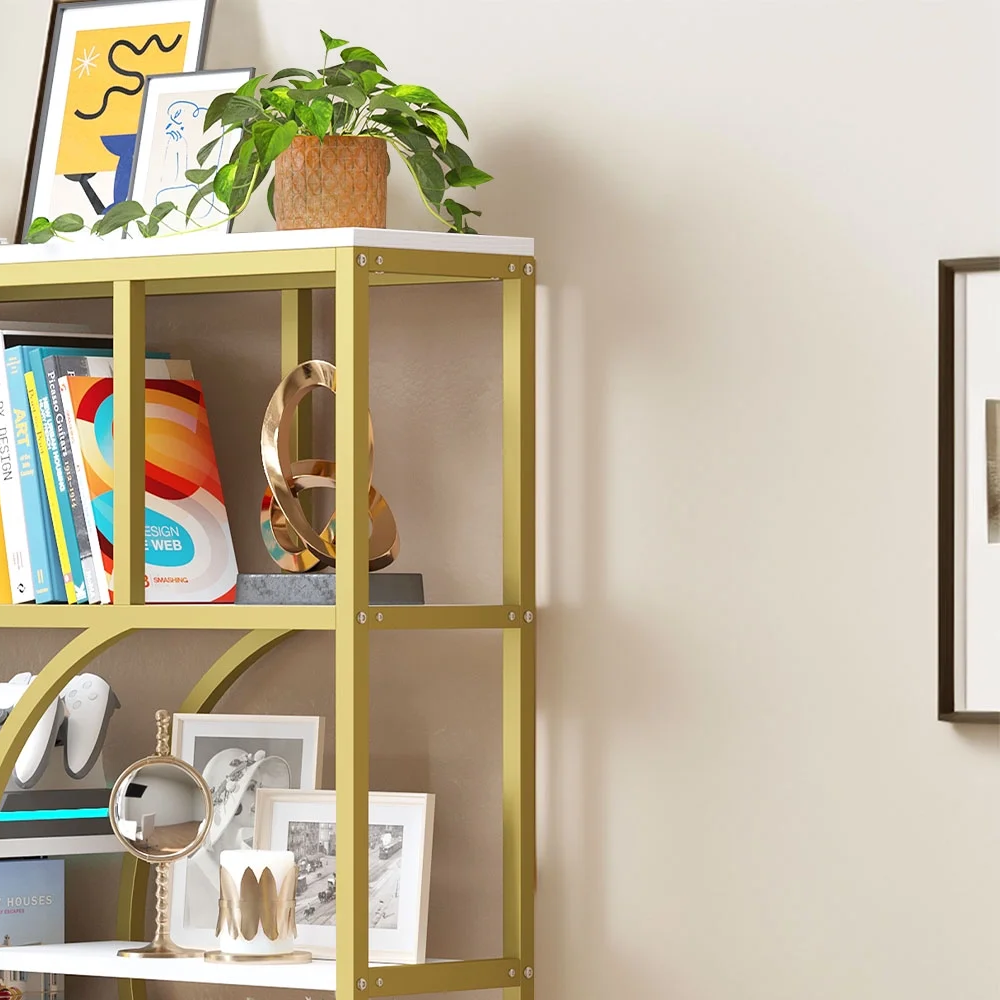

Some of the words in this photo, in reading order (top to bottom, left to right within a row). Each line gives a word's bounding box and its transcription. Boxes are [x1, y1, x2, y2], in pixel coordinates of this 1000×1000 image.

[47, 369, 60, 412] Picasso
[54, 412, 70, 457] Guitars
[13, 408, 29, 447] ART
[144, 526, 180, 537] ESIGN
[150, 540, 183, 551] WEB
[7, 895, 53, 908] HOUSES
